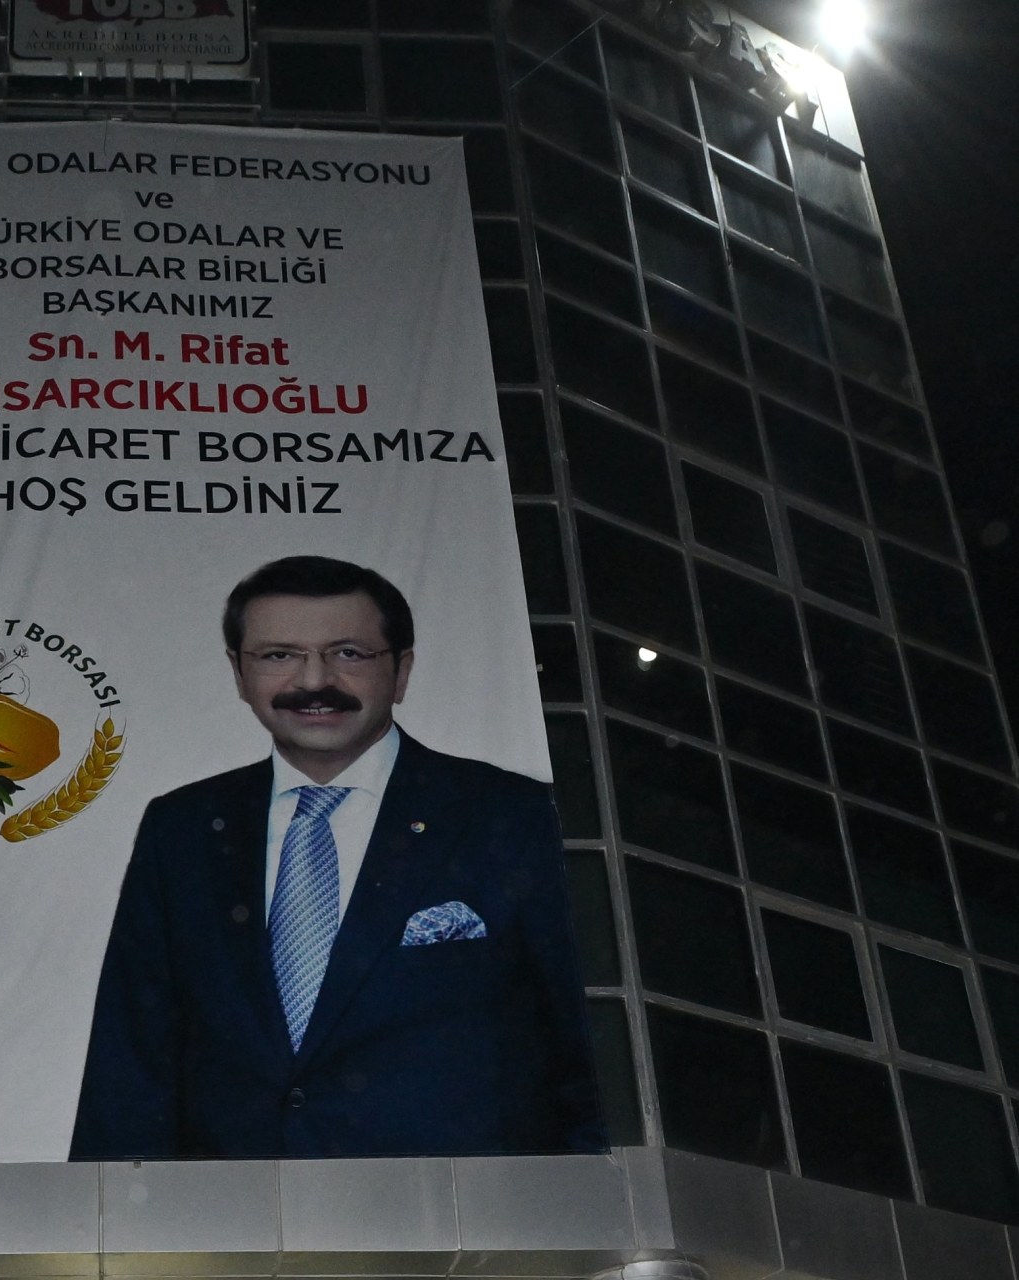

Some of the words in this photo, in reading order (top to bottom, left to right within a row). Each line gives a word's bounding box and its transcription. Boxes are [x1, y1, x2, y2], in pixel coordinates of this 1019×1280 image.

[156, 31, 230, 42] BORSA
[8, 152, 158, 175] ODALAR
[171, 155, 431, 186] FEDERASYONU
[135, 191, 174, 209] ve
[134, 221, 286, 249] ODALAR
[297, 227, 344, 250] VE
[199, 255, 327, 285] BİRLİĞİ
[43, 289, 274, 320] BAŞKANIMIZ
[28, 331, 98, 362] Sn.
[115, 331, 165, 362] M.
[181, 333, 290, 366] Rifat
[198, 428, 496, 463] BORSAMIZA
[105, 476, 342, 514] GELDİNİZ
[24, 622, 121, 708] BORSASI
